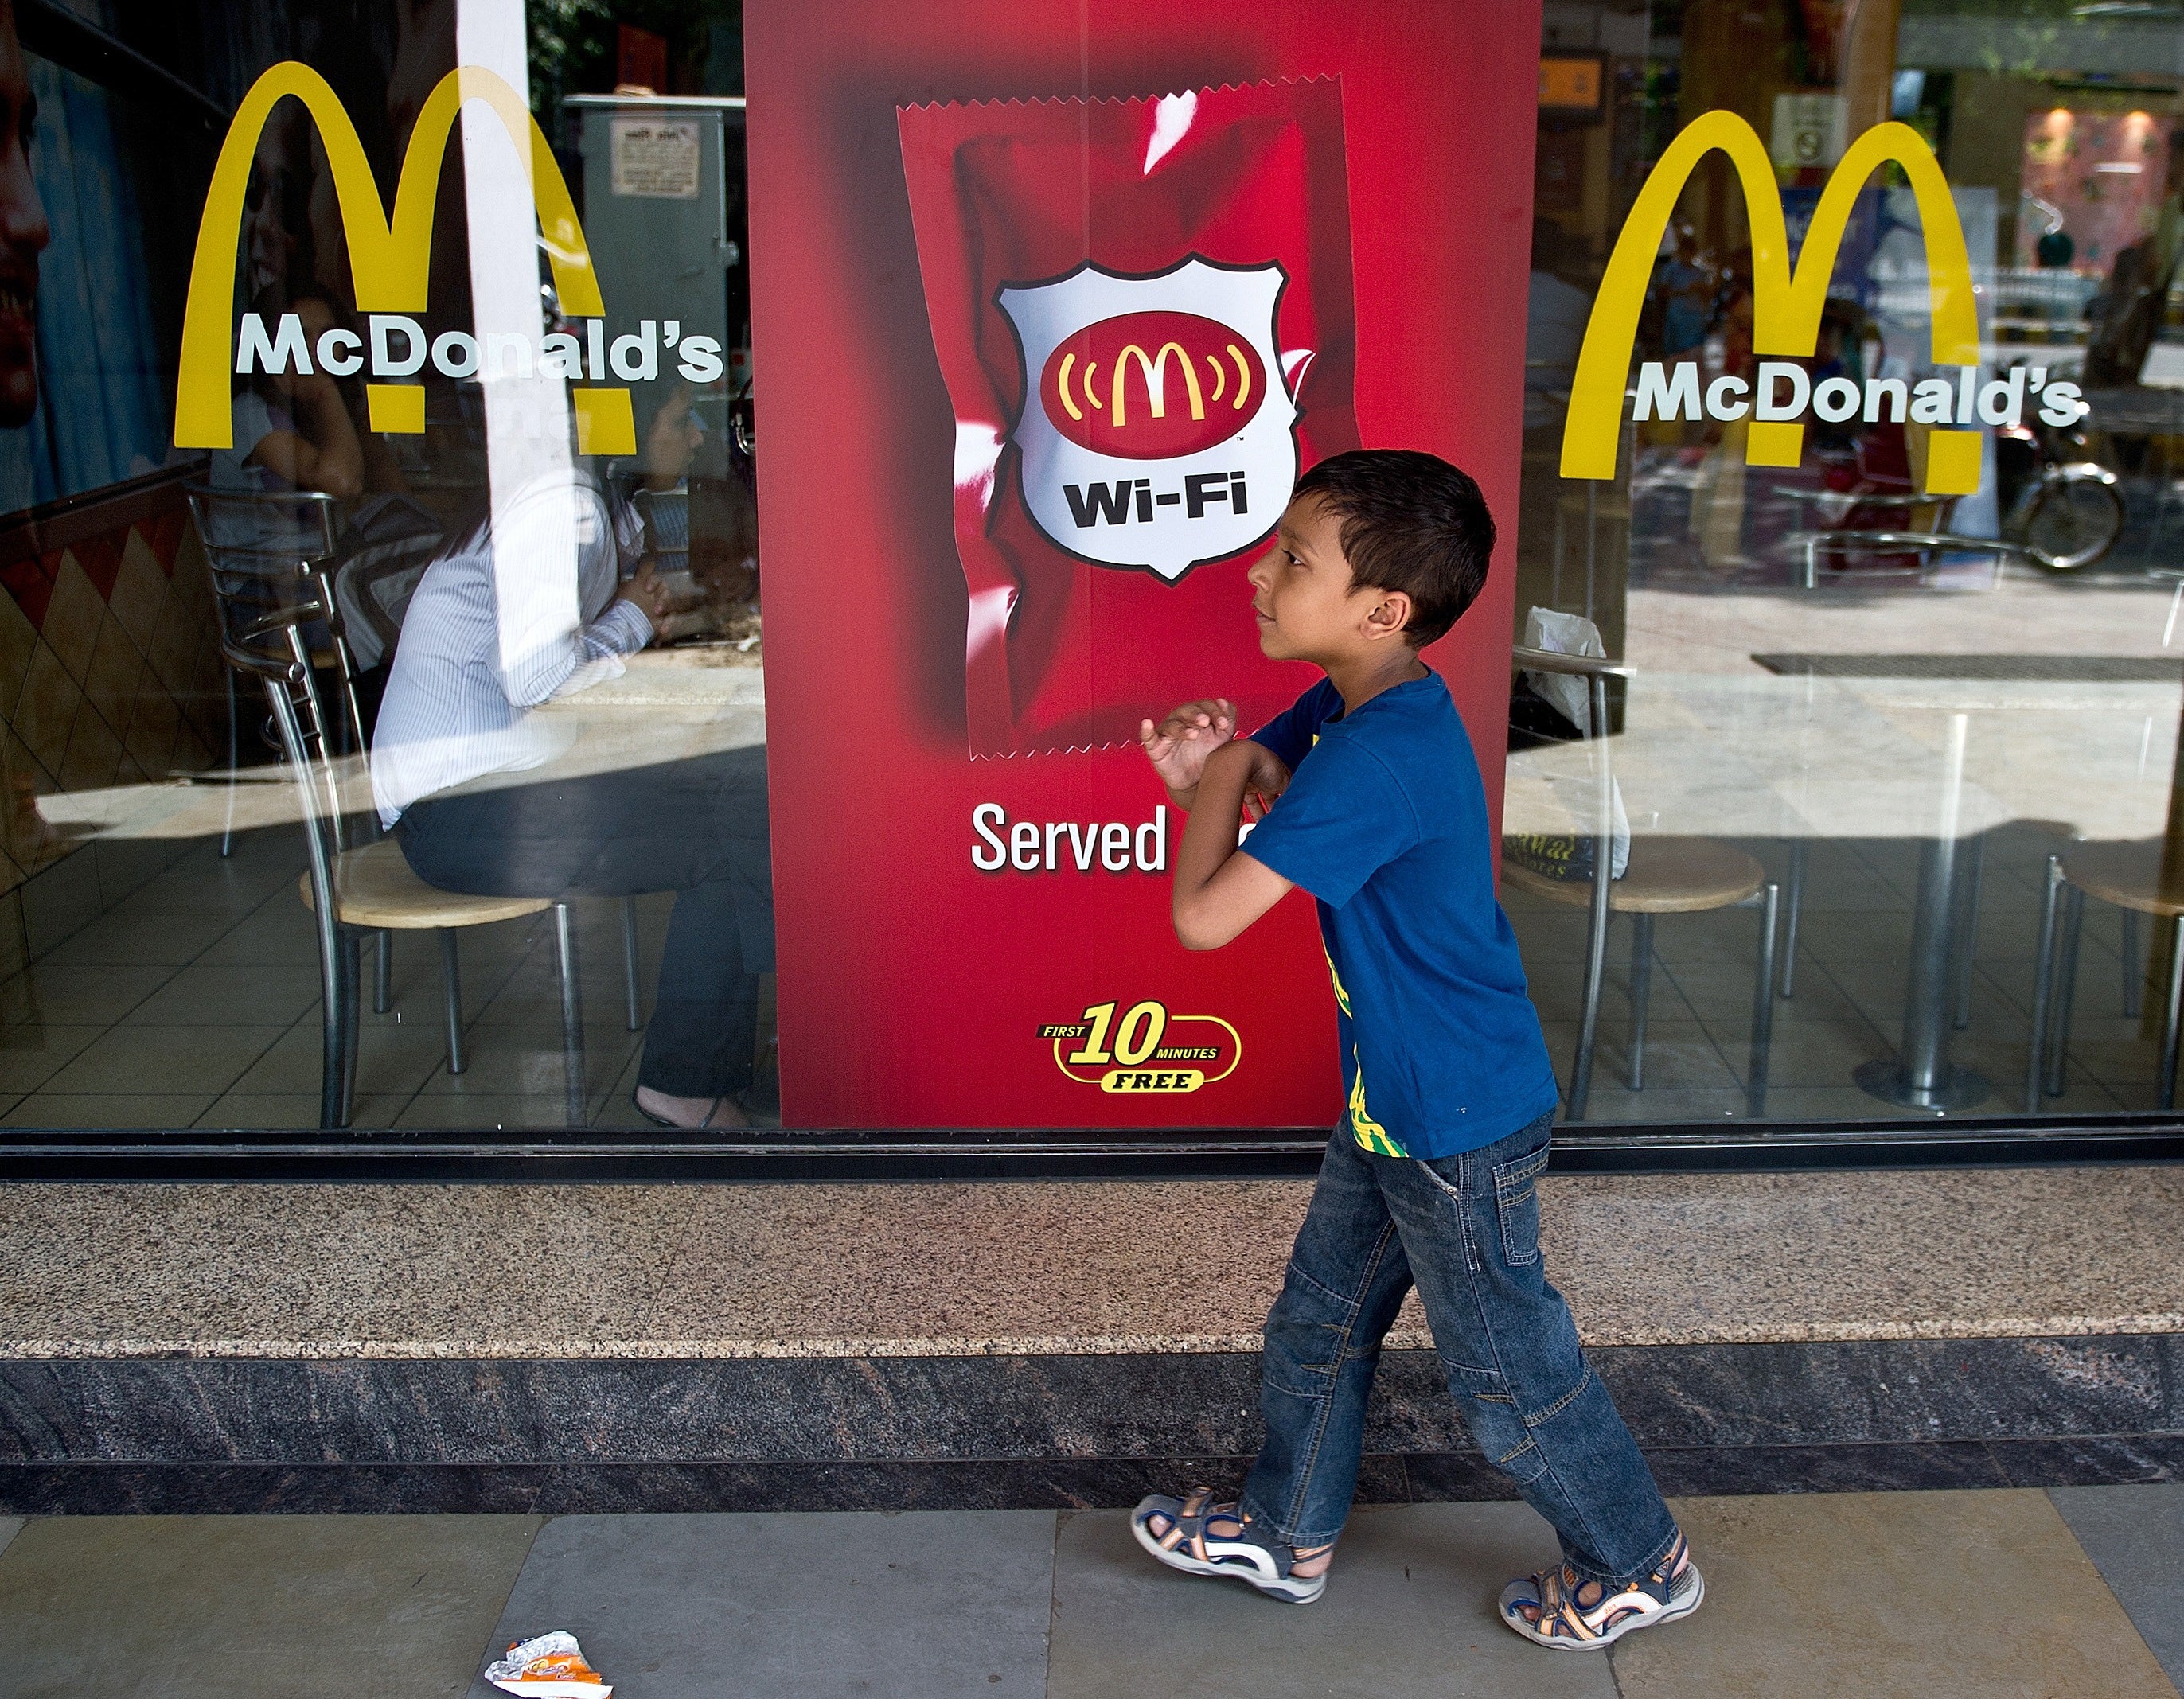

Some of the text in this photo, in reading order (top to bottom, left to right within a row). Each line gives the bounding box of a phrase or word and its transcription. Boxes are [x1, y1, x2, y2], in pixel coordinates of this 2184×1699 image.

[236, 313, 723, 384] McDonald's
[1632, 361, 2083, 427] McDonald's
[1063, 471, 1248, 528] Wi-Fi
[971, 803, 1166, 871] Served
[1043, 1001, 1218, 1066] FIRST 10 MINUTES
[1113, 1074, 1193, 1089] FREE
